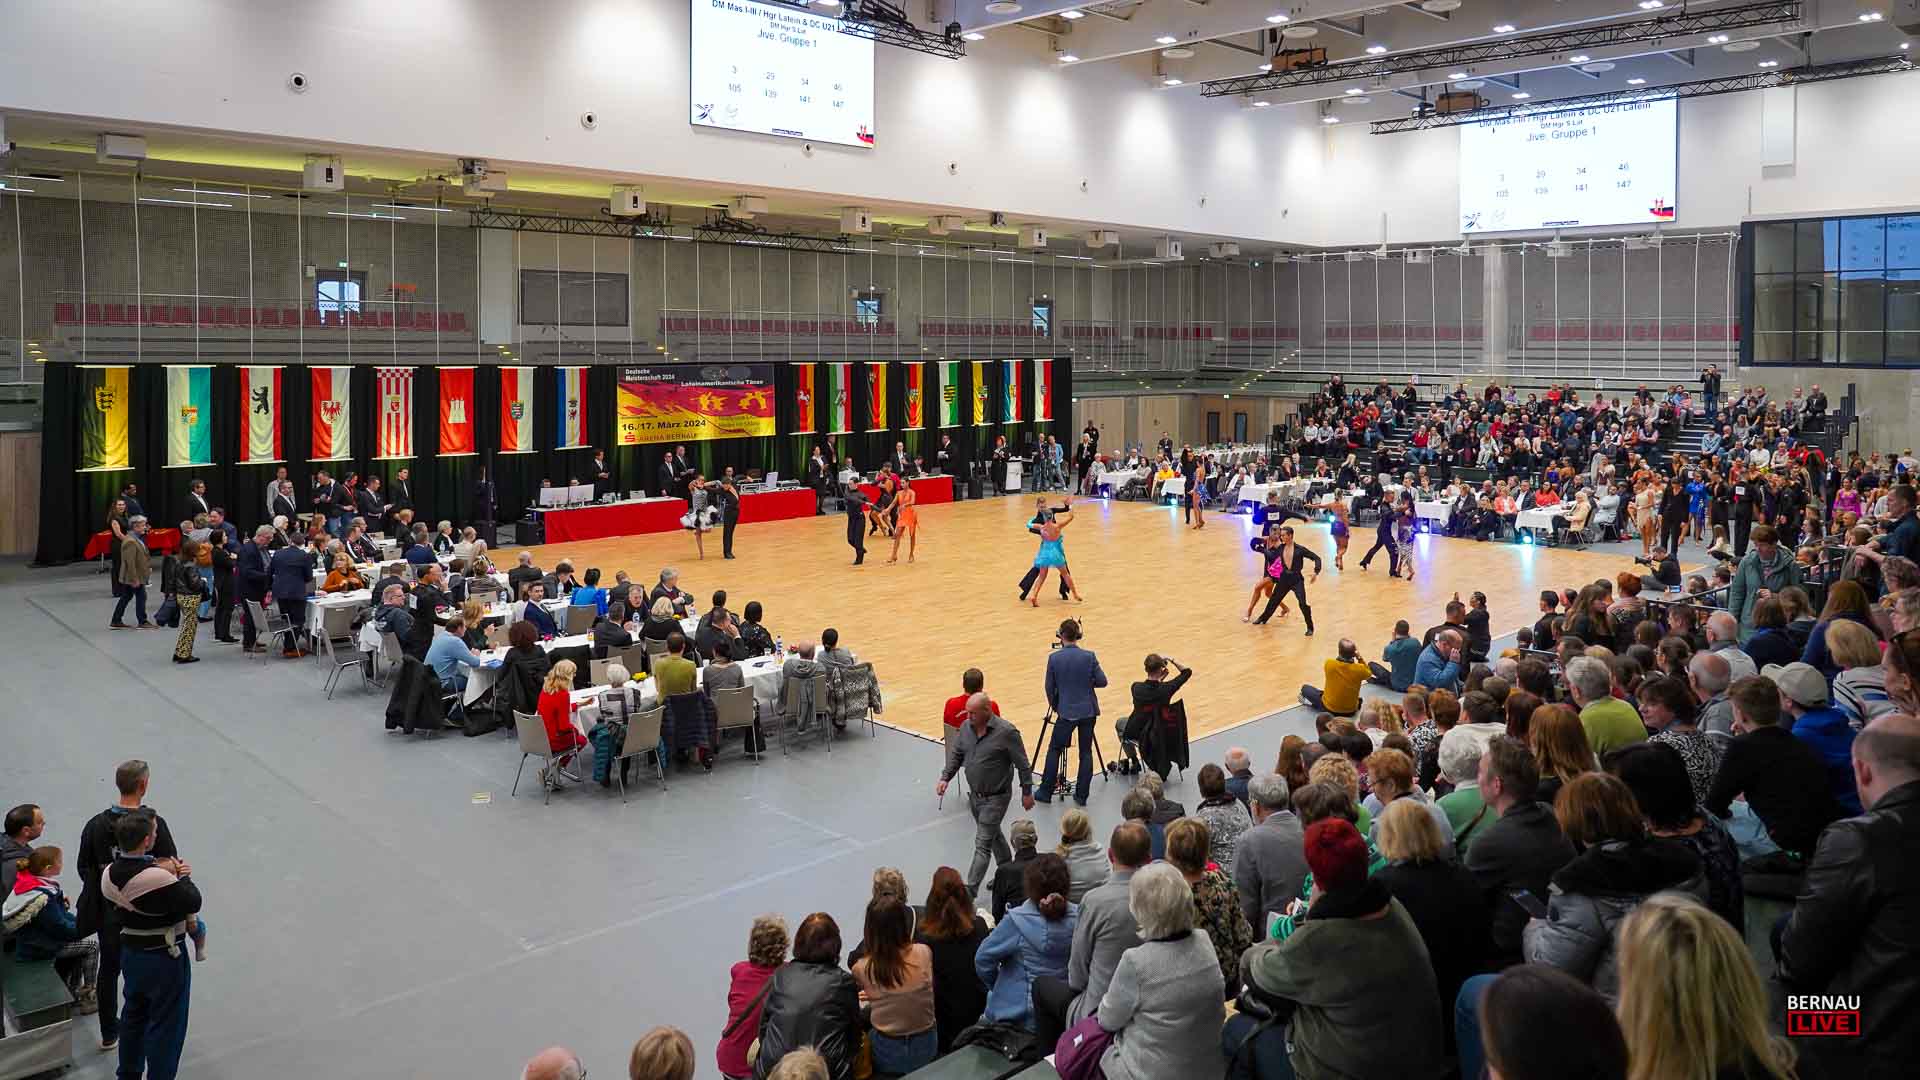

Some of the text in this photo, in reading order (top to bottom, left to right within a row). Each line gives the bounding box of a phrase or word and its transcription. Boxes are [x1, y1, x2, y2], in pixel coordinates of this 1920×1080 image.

[822, 22, 835, 32] U21
[779, 32, 811, 49] Gruppe
[1551, 128, 1588, 140] Gruppe
[625, 374, 661, 382] Meisterschaft
[657, 420, 680, 429] März
[683, 419, 706, 428] 2024
